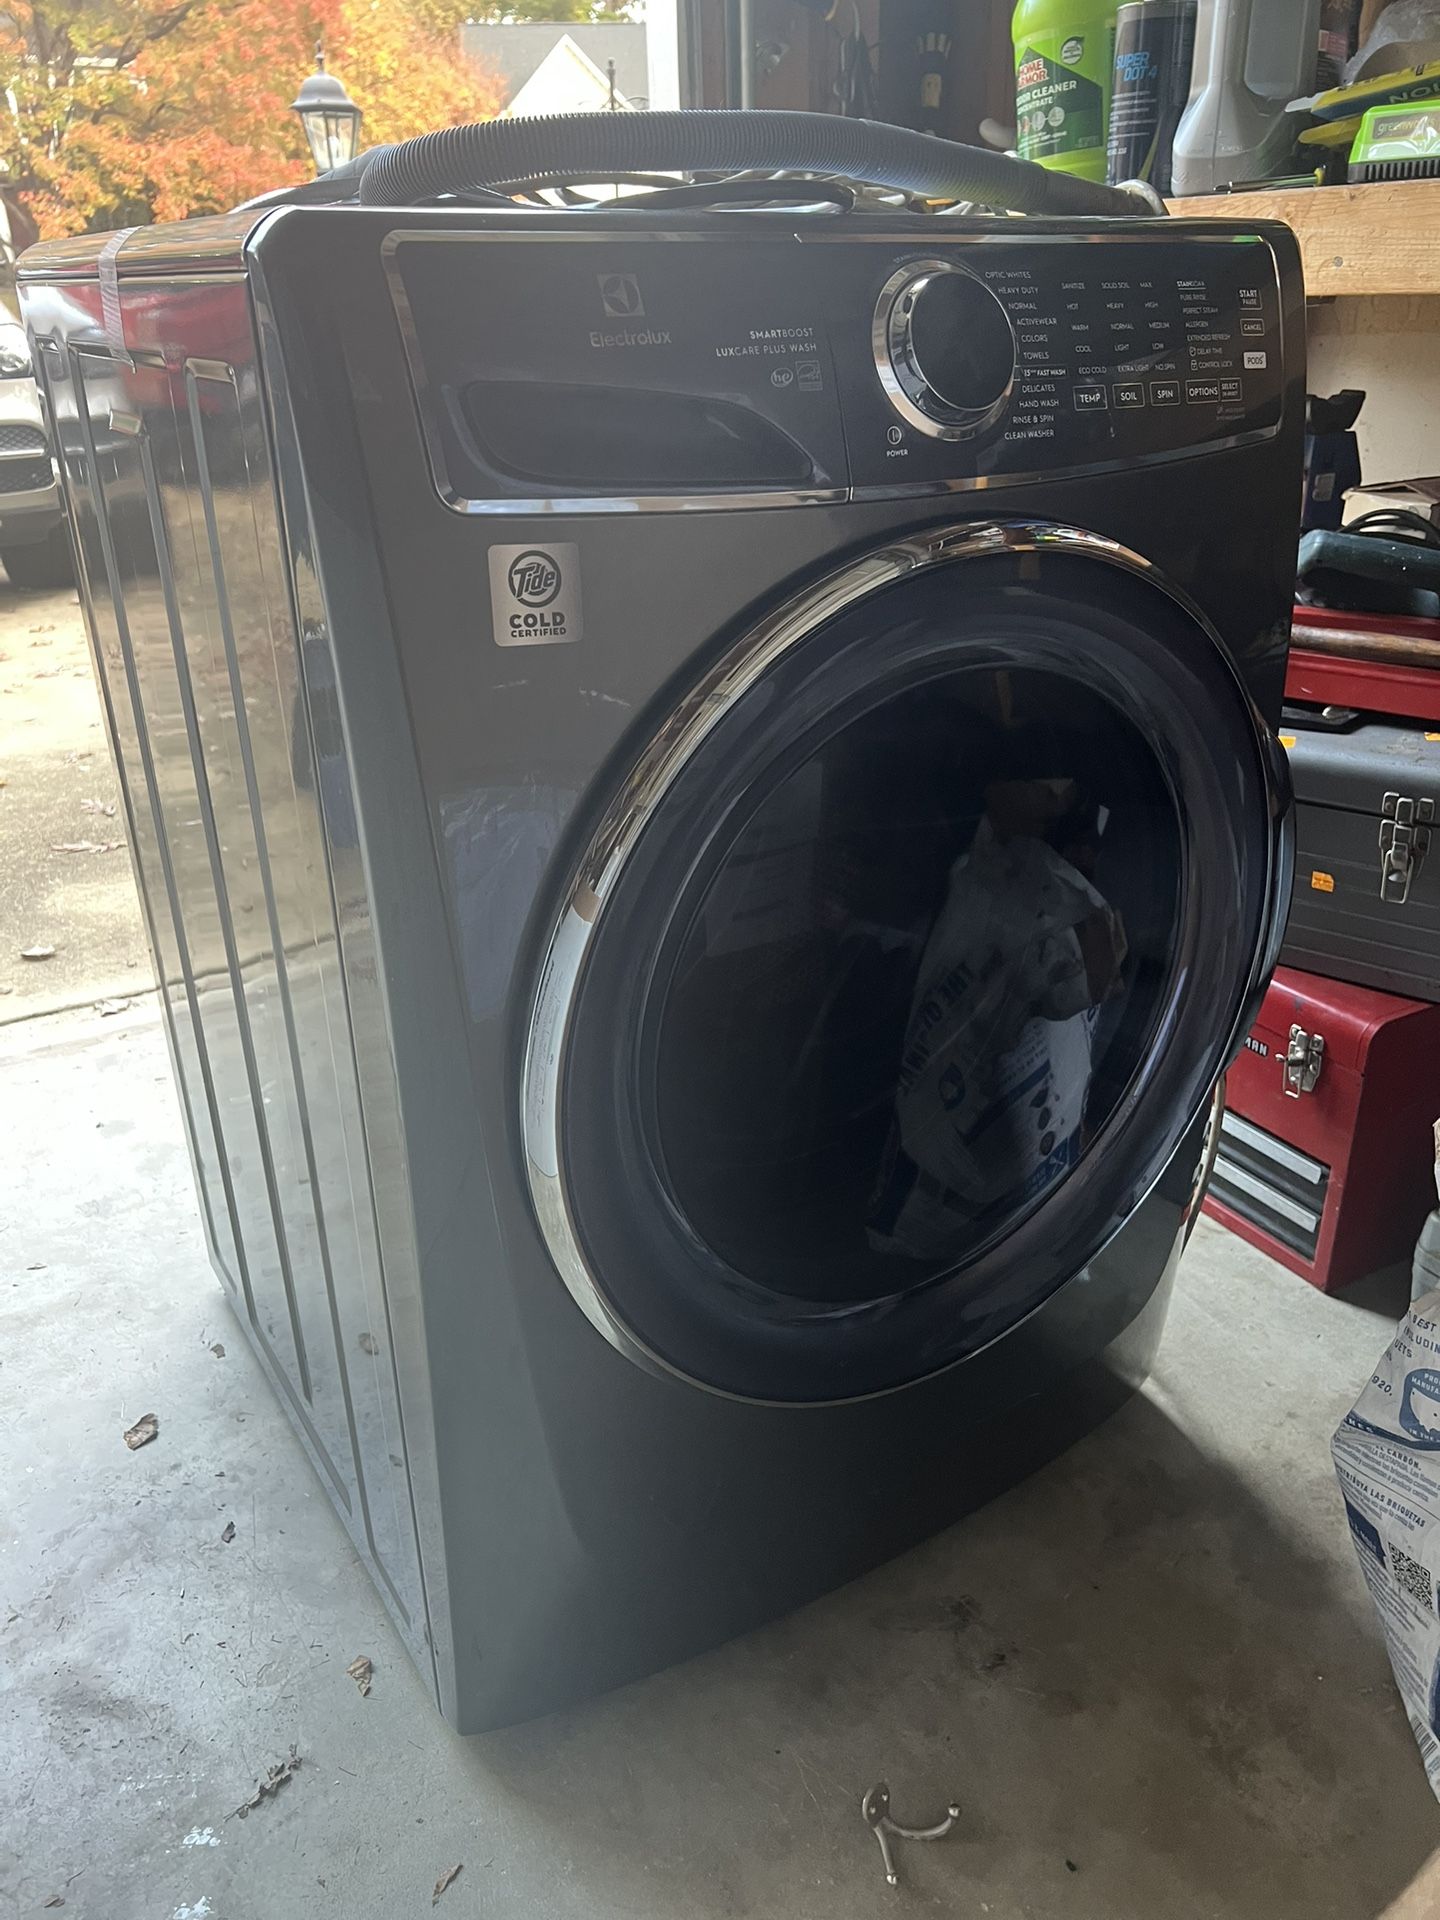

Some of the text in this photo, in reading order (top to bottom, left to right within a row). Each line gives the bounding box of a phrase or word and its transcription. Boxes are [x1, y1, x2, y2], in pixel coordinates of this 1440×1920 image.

[1116, 52, 1149, 69] SUPER
[1124, 66, 1146, 81] DOT
[1031, 80, 1077, 99] CLEANER
[985, 271, 1031, 279] OPTIC WHITES
[1021, 286, 1039, 294] DUTY
[1239, 289, 1258, 298] START
[1067, 303, 1079, 311] HOT
[1016, 318, 1057, 326] ACTIVEWEAR
[1110, 323, 1134, 331] NORMAL
[1243, 323, 1262, 331] CANCEL
[589, 328, 673, 348] Electrolux
[750, 328, 814, 339] SMARTBOOST
[1021, 334, 1048, 343] COLORS
[716, 342, 817, 357] LUXCARE PLUS WASH
[1075, 345, 1092, 353] COOL
[1114, 343, 1130, 352] LIGHT
[1023, 352, 1050, 360] TOWELS
[1050, 368, 1066, 376] WASH
[1079, 366, 1107, 375] ECO COLD
[1117, 365, 1134, 373] EXTRA
[1022, 384, 1056, 393] DELICATES
[1221, 382, 1239, 390] SELECT
[1120, 391, 1137, 401] SOIL
[1157, 389, 1174, 399] SPIN
[1189, 386, 1218, 397] OPTIONS
[1080, 393, 1101, 403] TEMP
[1020, 400, 1060, 408] HAND WASH
[1012, 416, 1033, 424] RINSE
[1040, 414, 1054, 423] SPIN
[1004, 429, 1055, 440] CLEAN WASHER
[886, 449, 909, 457] POWER
[513, 563, 557, 598] Tide
[509, 611, 566, 629] COLD
[510, 627, 567, 638] CERTIFIED
[1412, 1313, 1437, 1332] BEST
[1370, 1488, 1385, 1503] LAS
[1386, 1496, 1426, 1528] BRIQUETAS
